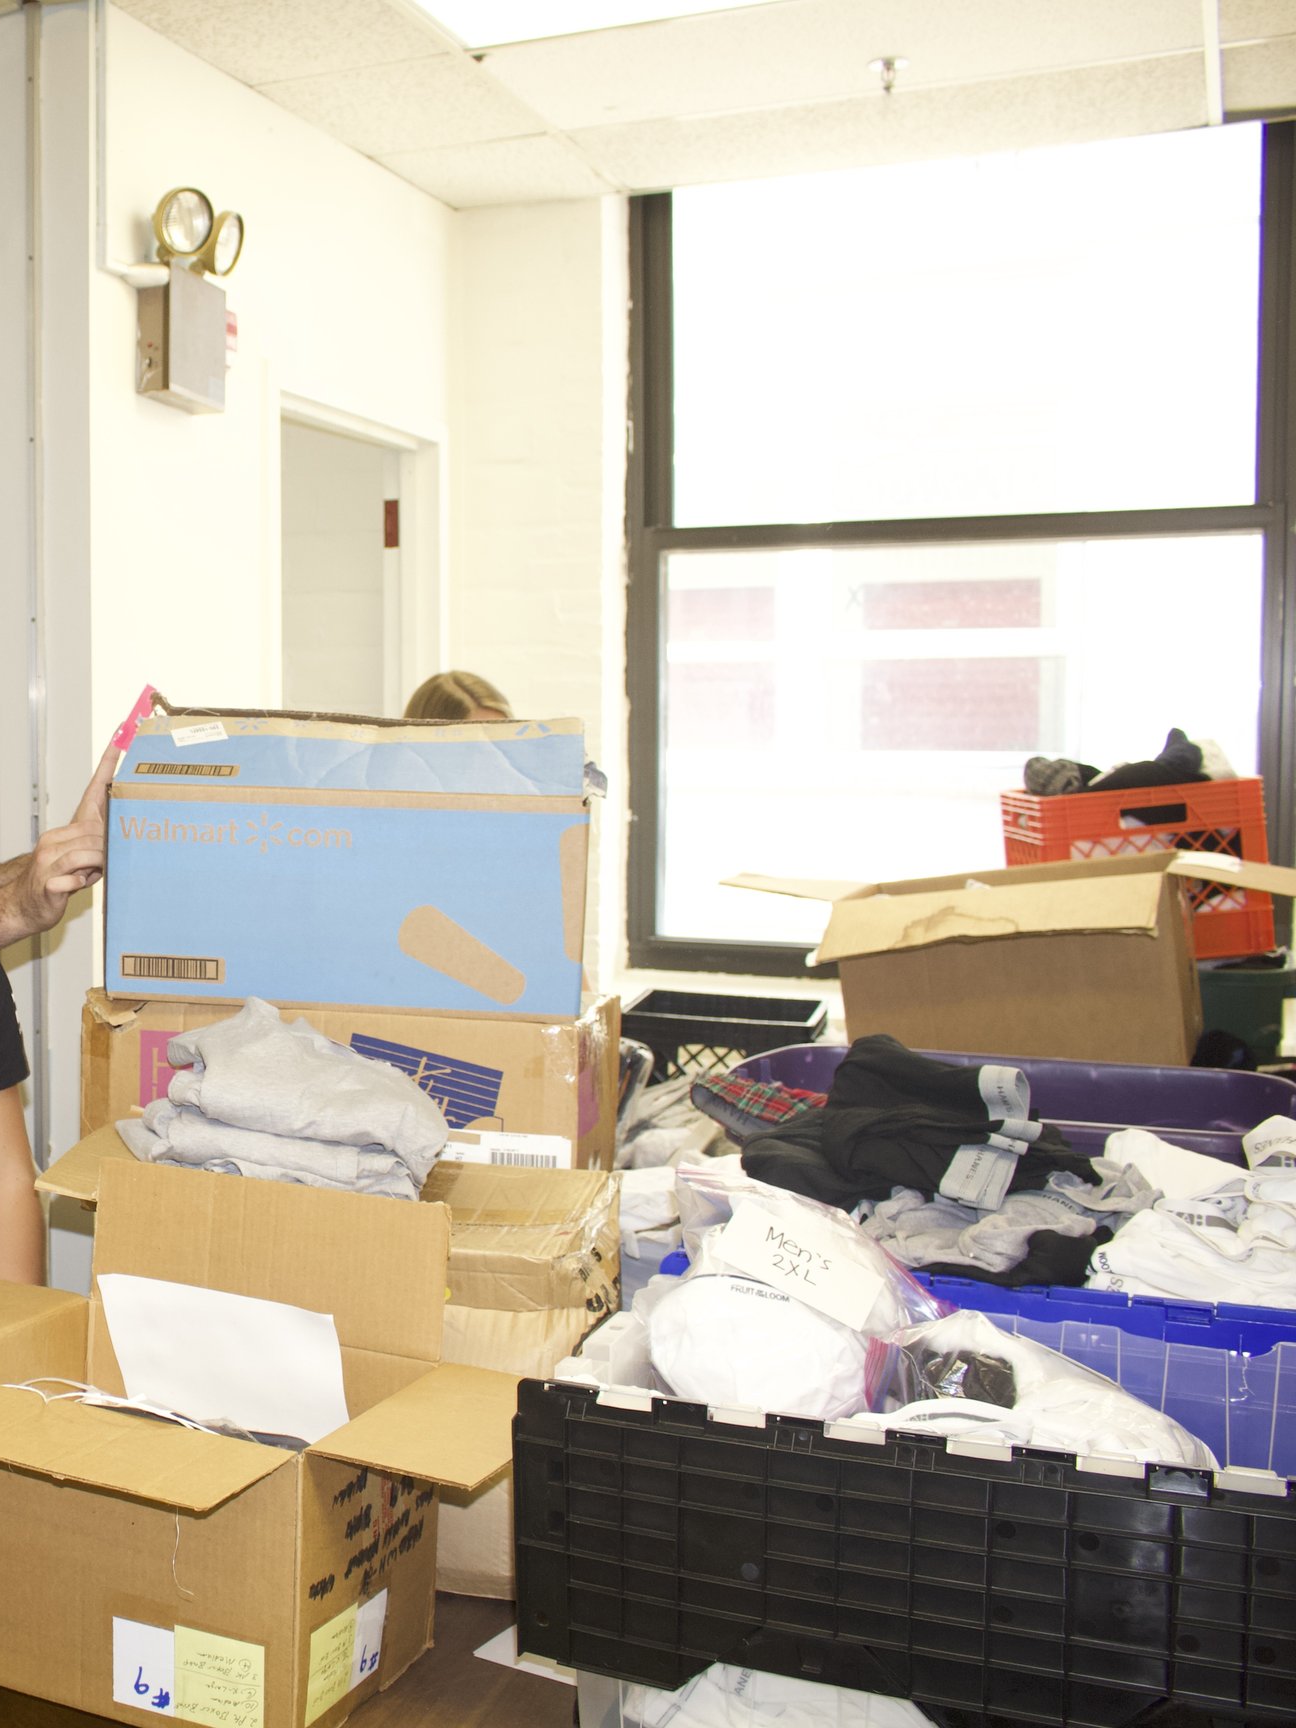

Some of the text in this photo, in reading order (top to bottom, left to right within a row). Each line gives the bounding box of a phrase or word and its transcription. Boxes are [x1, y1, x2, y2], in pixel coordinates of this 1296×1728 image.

[119, 815, 238, 845] Walmart
[765, 1226, 832, 1271] Men's
[772, 1254, 816, 1286] 2XL
[764, 1291, 790, 1303] LOOM
